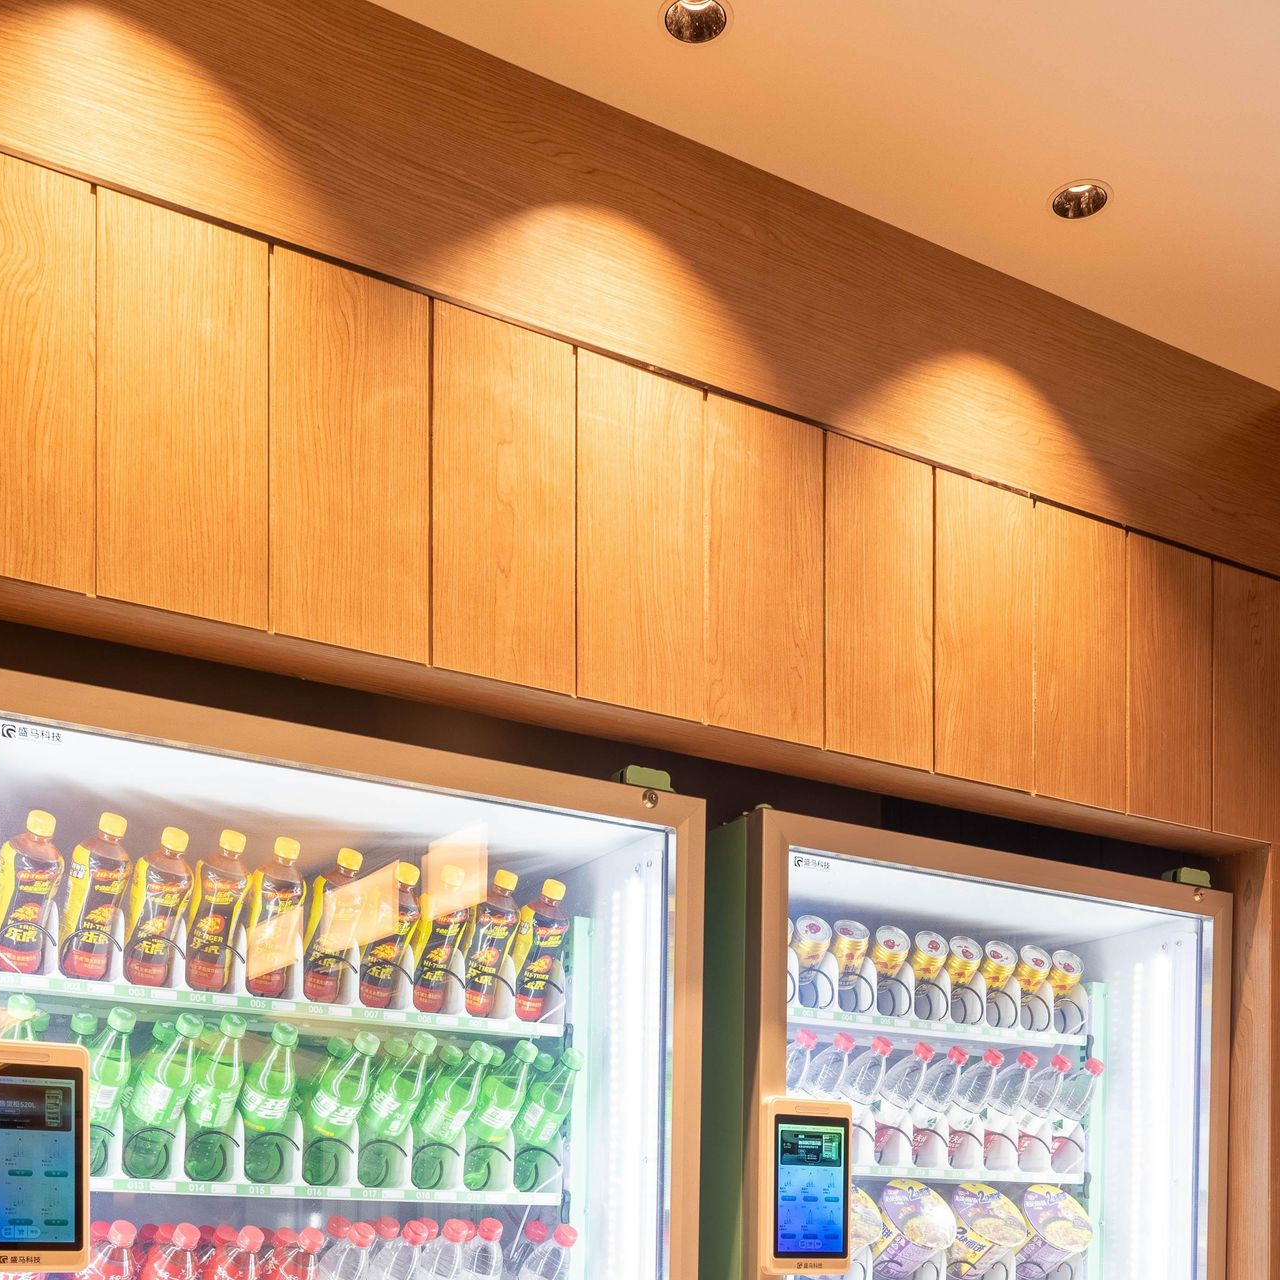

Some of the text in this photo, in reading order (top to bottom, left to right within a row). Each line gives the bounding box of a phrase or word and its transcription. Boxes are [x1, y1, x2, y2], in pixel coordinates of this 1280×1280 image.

[128, 987, 145, 997] 003
[190, 993, 206, 1003] 004
[250, 999, 266, 1008] 005
[308, 1005, 324, 1014] 006
[364, 1010, 379, 1019] 007
[128, 1181, 144, 1190] 013
[189, 1183, 205, 1192] 014
[249, 1185, 265, 1194] 015
[307, 1187, 322, 1196] 016
[362, 1189, 377, 1198] 017
